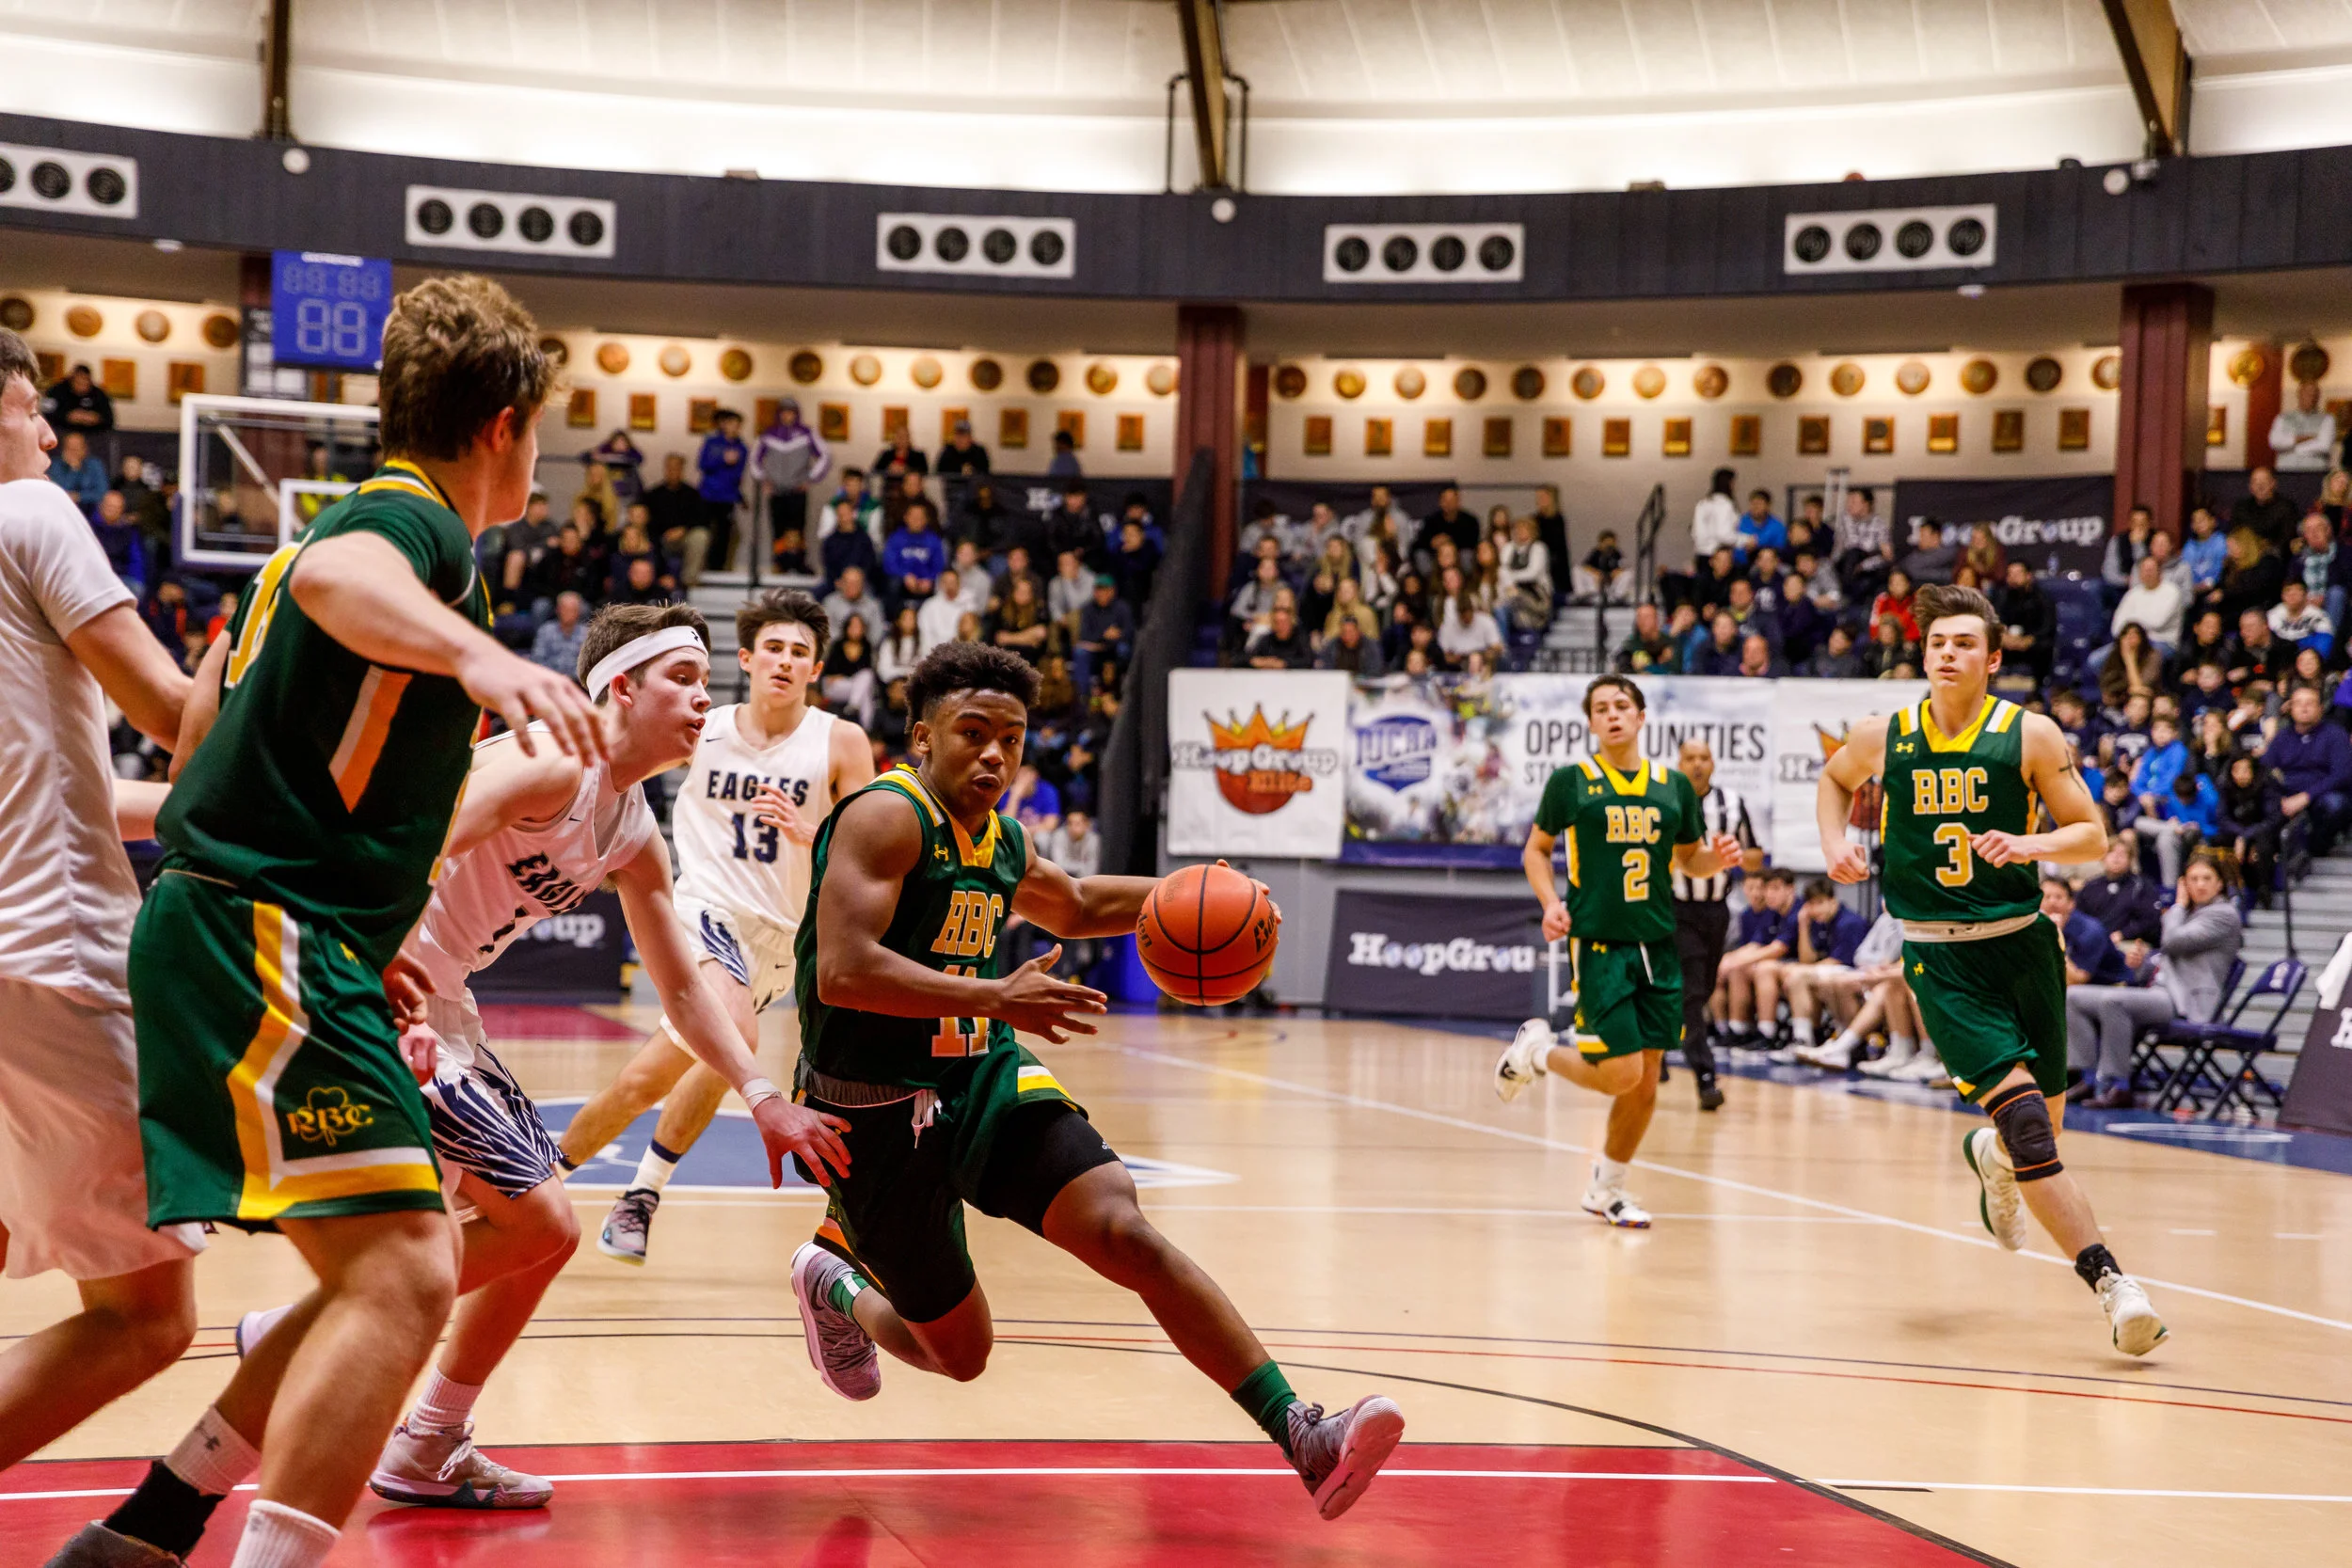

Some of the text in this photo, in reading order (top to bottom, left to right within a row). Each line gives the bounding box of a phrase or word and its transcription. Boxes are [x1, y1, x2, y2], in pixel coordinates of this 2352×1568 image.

[1912, 767, 1989, 815] RBC
[732, 813, 779, 863] 13
[1605, 805, 1661, 844] RBC
[1622, 847, 1650, 902] 2
[1933, 822, 1974, 887] 3
[930, 890, 1004, 958] RBC
[1347, 931, 1536, 975] HoopGrou
[286, 1104, 374, 1135] RBC
